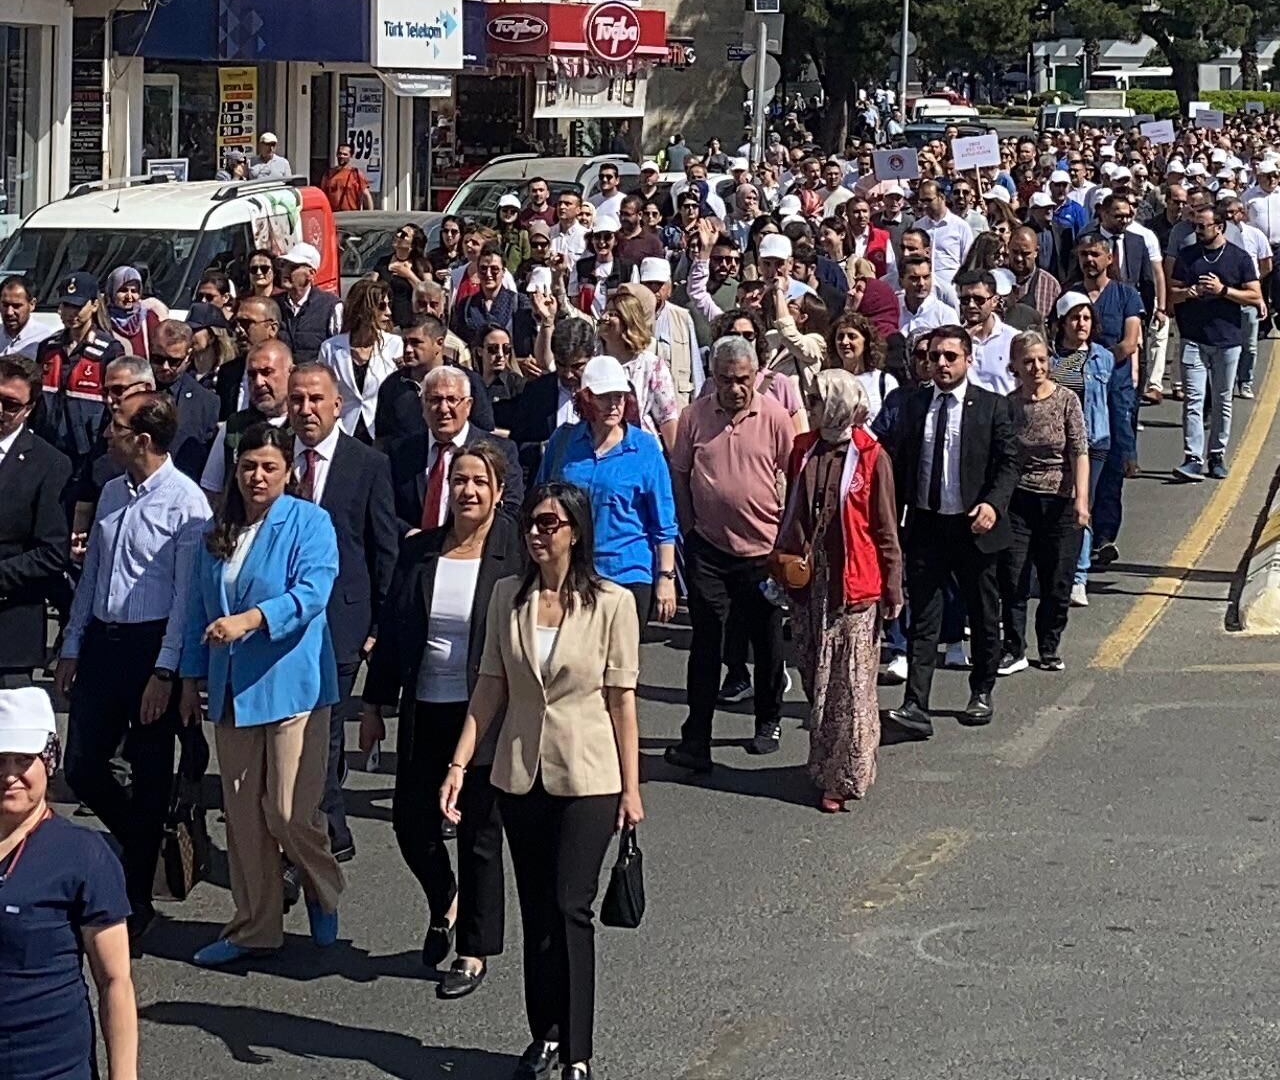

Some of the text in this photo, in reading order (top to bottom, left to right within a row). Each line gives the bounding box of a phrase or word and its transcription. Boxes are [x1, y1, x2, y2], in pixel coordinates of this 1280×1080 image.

[384, 20, 442, 39] Türk Telekom
[347, 129, 373, 160] 399
